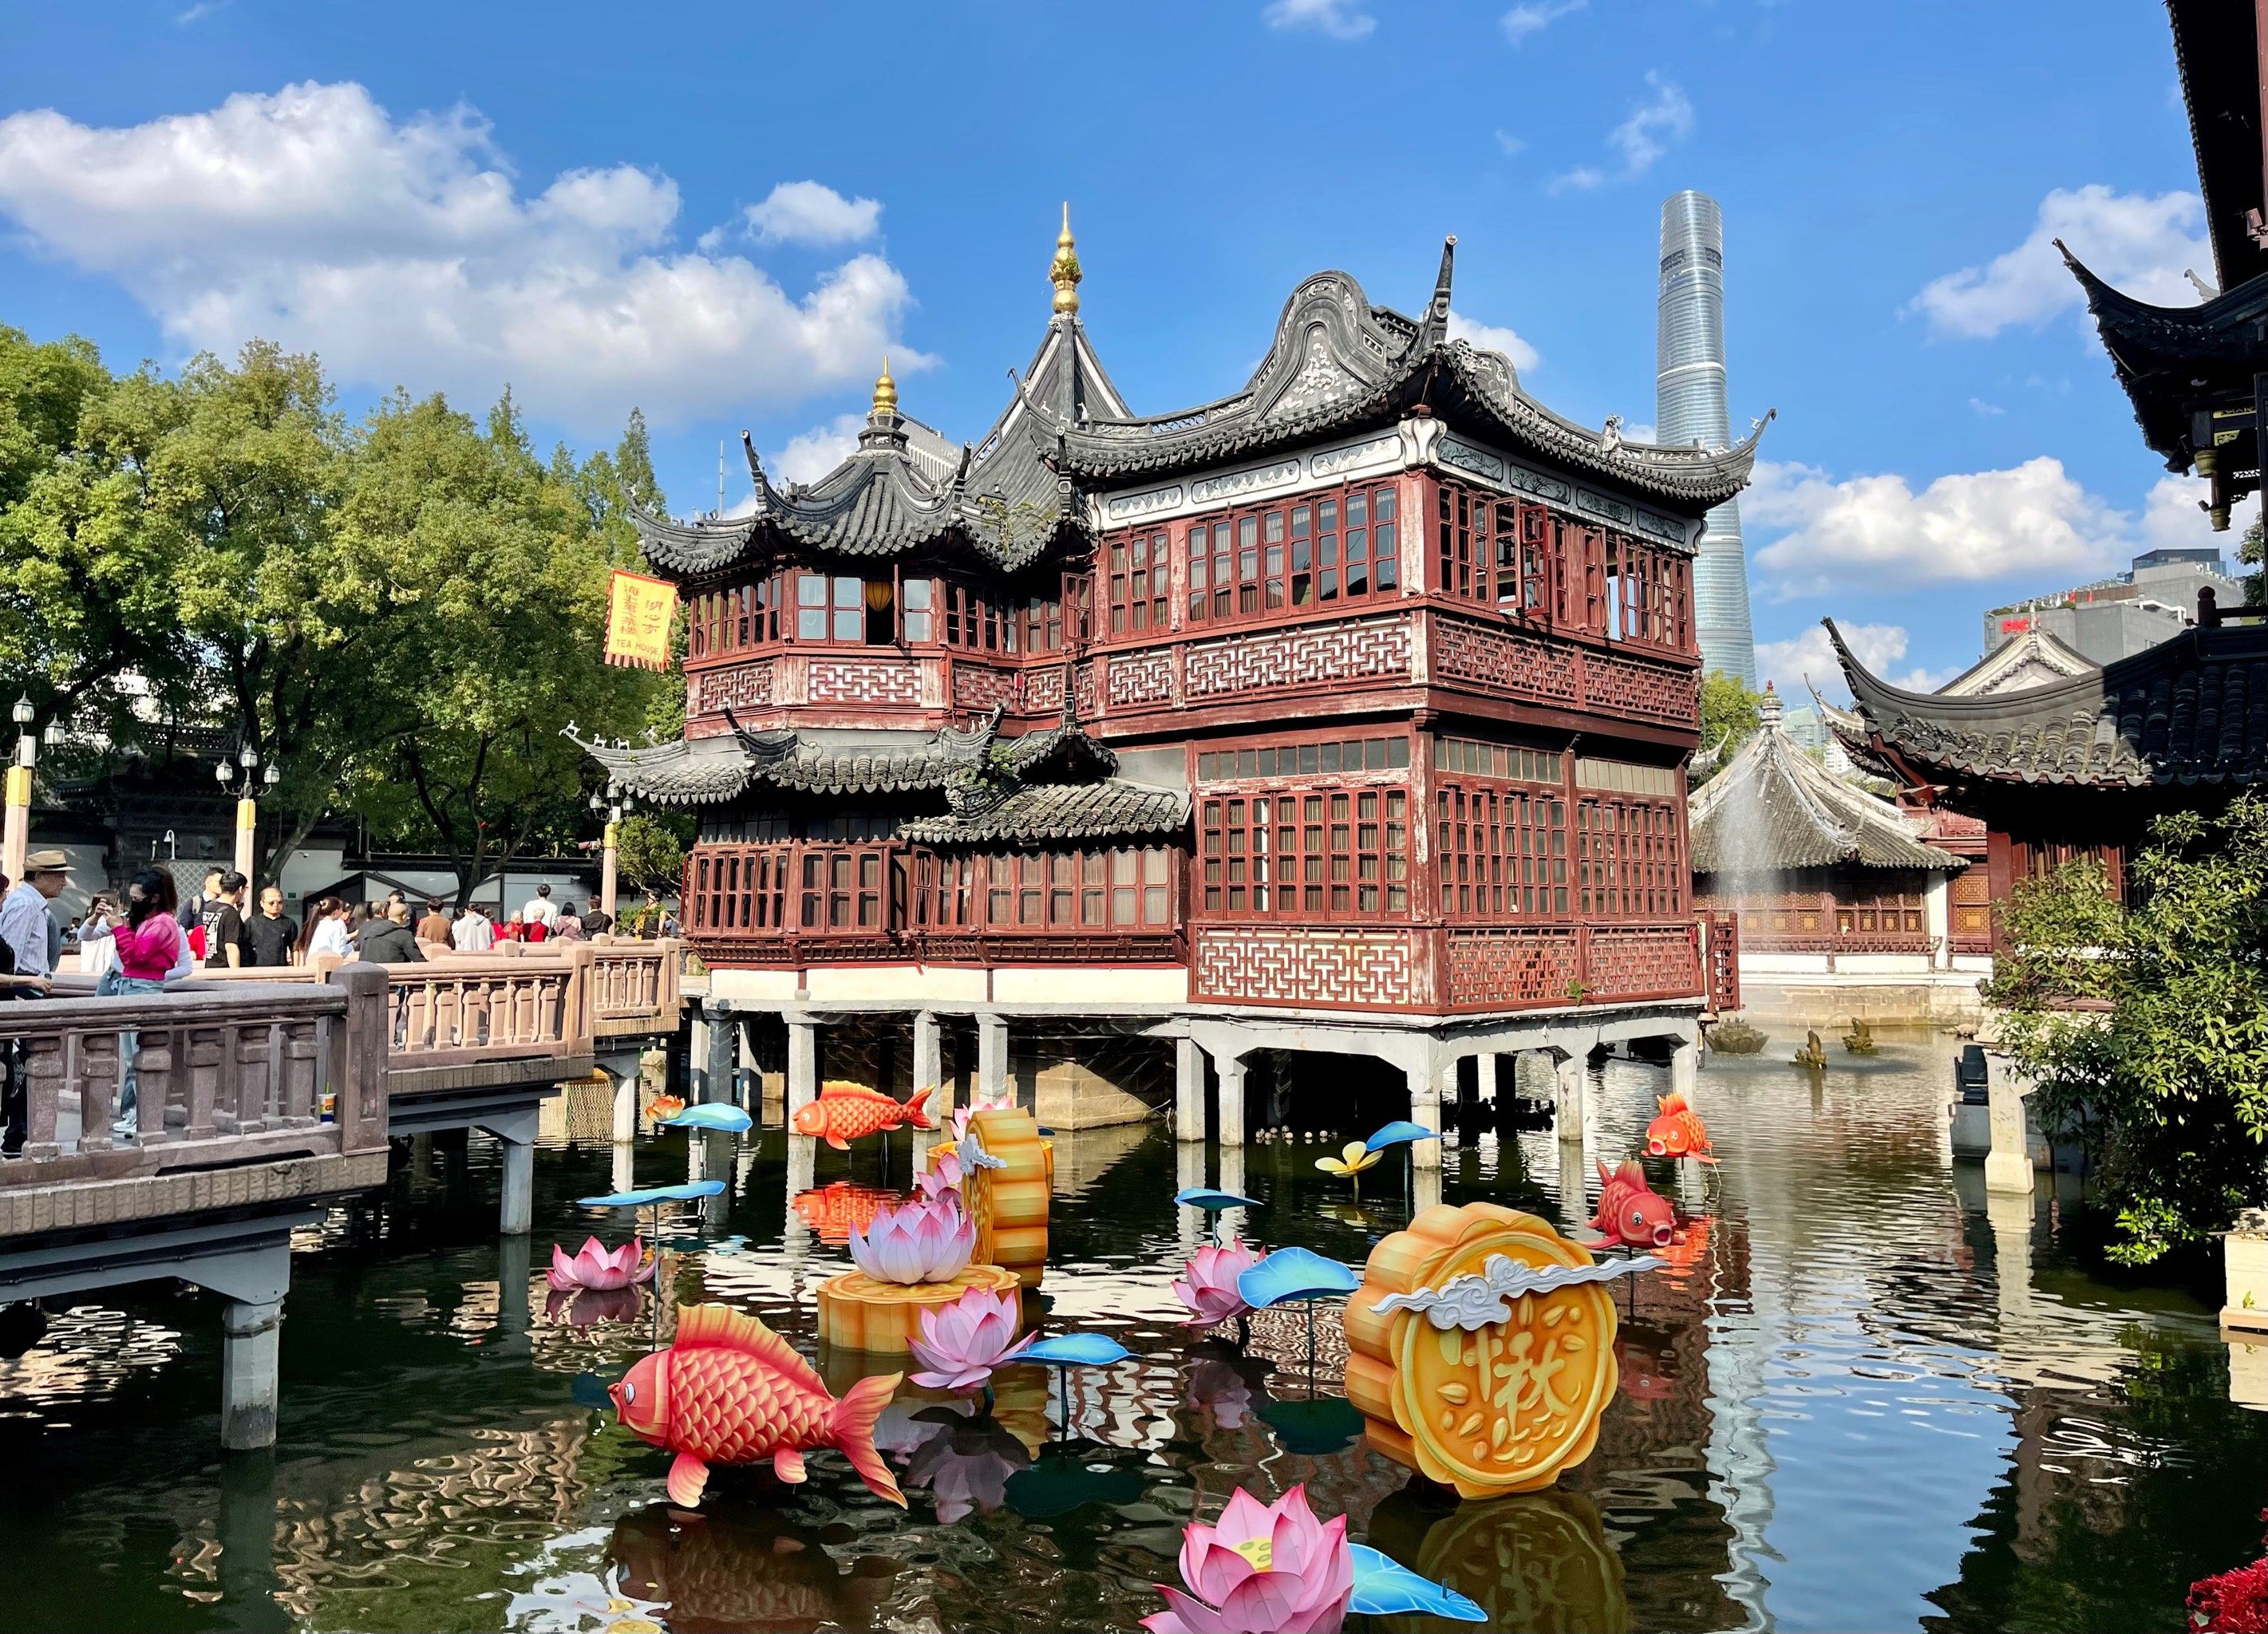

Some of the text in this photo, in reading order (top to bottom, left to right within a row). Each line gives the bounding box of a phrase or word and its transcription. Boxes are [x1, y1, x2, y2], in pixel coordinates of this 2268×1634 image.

[641, 599, 663, 634] 湖心亭
[616, 638, 659, 655] TEA HOUSE
